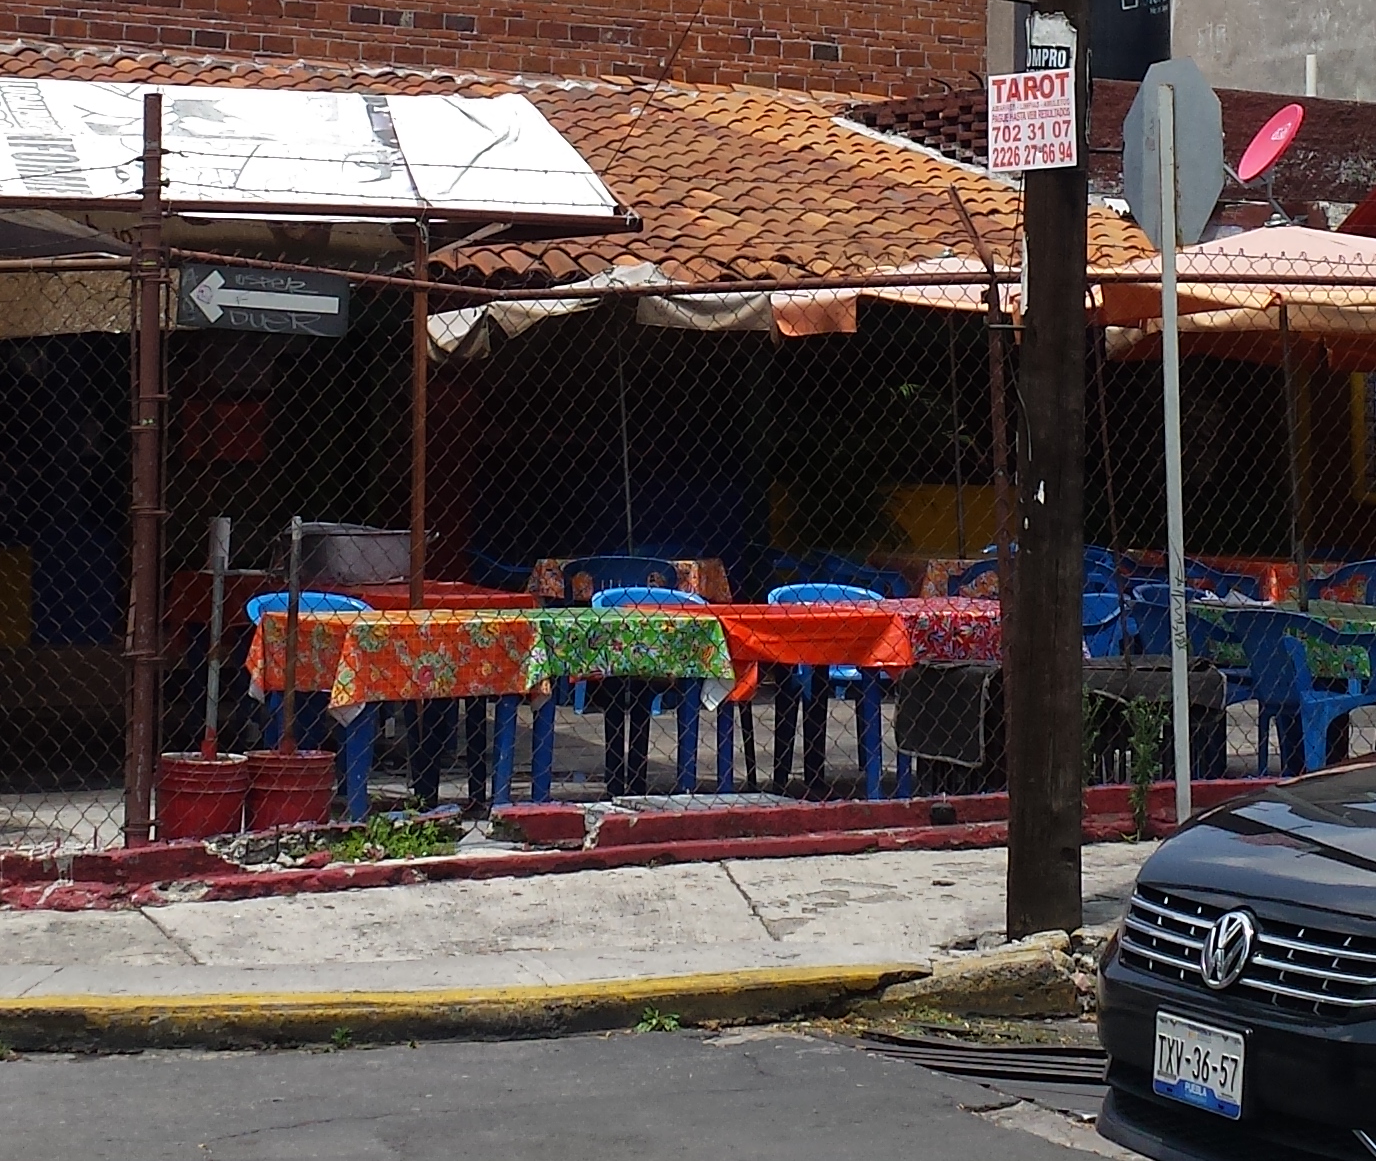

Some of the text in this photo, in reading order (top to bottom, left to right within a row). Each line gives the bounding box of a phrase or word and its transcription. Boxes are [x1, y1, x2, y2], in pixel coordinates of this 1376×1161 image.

[991, 71, 1070, 103] TAROT
[991, 119, 1072, 145] 702 31 07
[992, 140, 1073, 168] 2226 27 66 94
[1157, 1033, 1240, 1093] TXV-36-57
